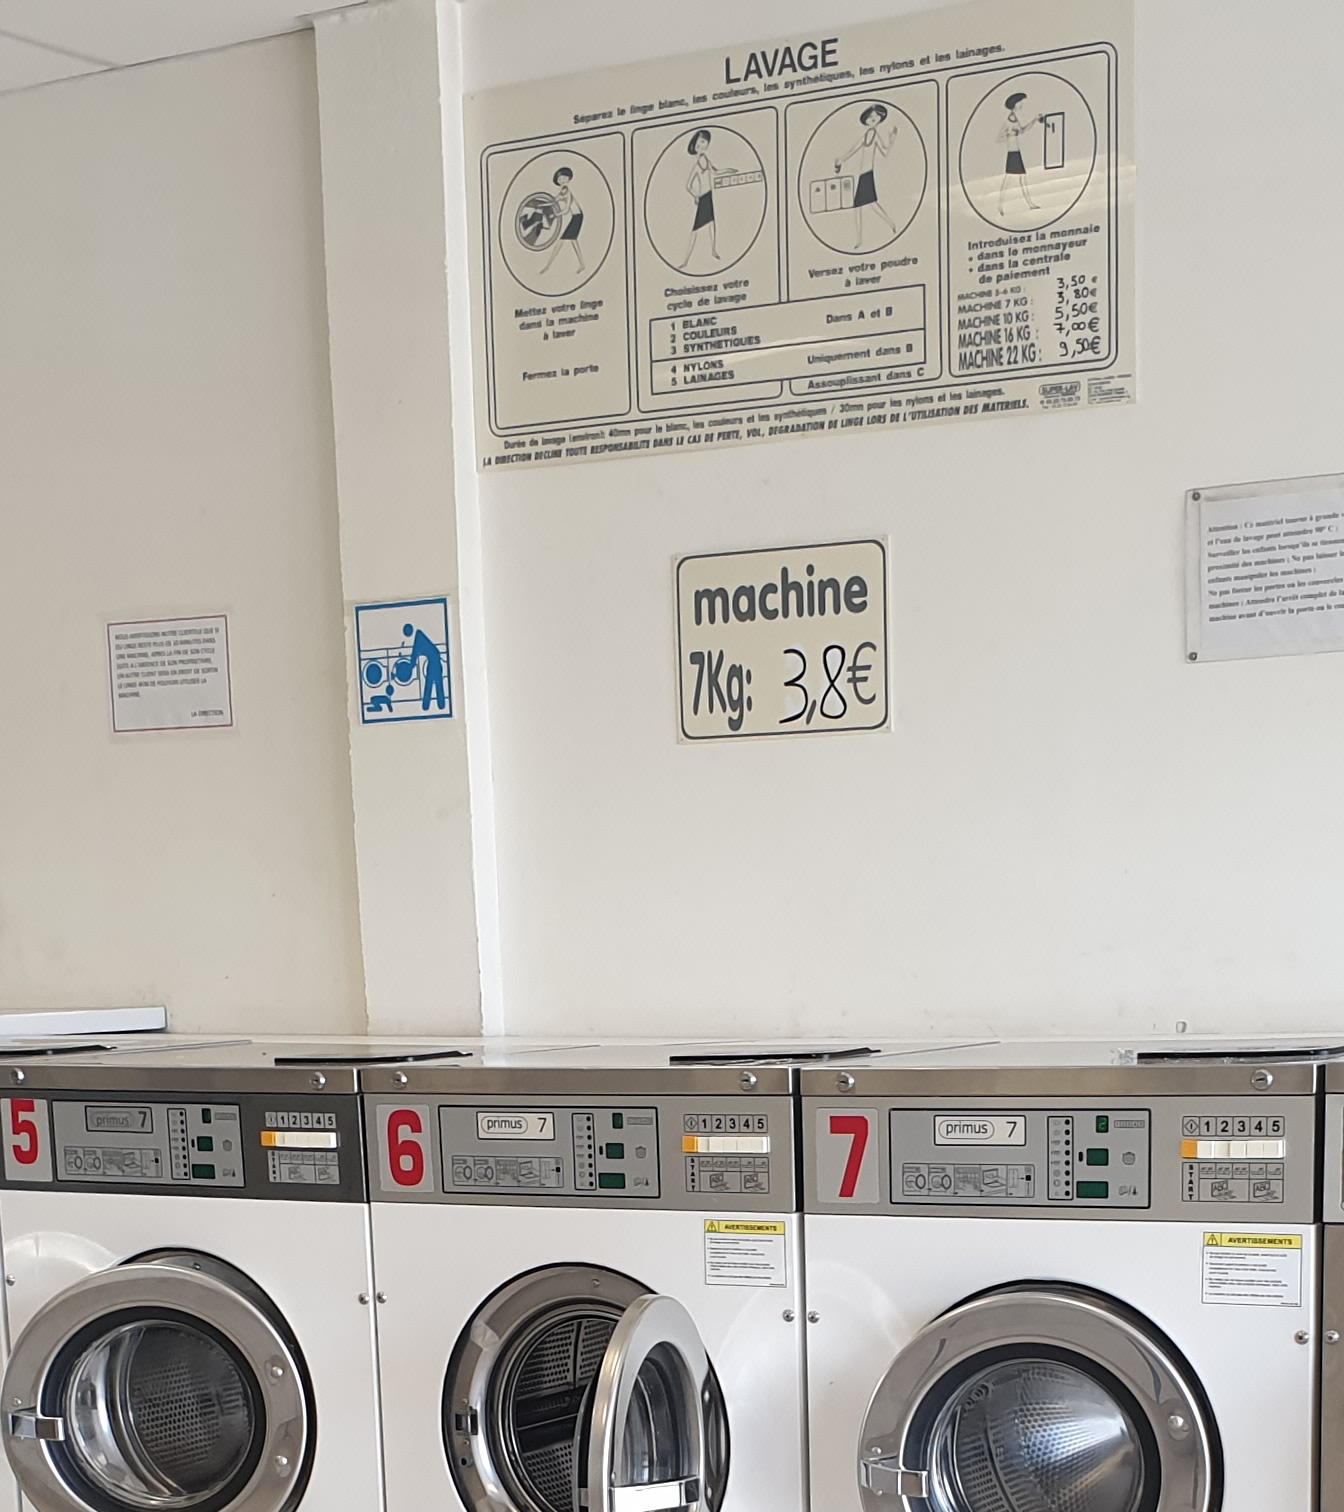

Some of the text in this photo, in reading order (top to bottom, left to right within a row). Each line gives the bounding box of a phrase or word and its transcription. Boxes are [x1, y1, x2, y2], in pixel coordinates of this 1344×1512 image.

[725, 38, 839, 84] LAVAGE
[968, 224, 1100, 251] Introduisez la monnaie
[977, 239, 1087, 261] dans le monnayeur
[978, 253, 1071, 272] dans la centrale
[979, 267, 1050, 284] de paiement
[958, 289, 992, 301] MACHINE
[1057, 275, 1085, 290] 3,50
[958, 300, 1002, 314] MACHINE
[1005, 299, 1010, 308] 7
[1014, 297, 1028, 307] KG
[671, 317, 717, 331] 1 BLANC
[826, 307, 892, 324] Dans A et B
[958, 302, 1098, 330] MACHINE 10 KG 5,50€
[671, 326, 737, 343] 2 COULEURS
[958, 317, 1099, 349] MACHINE 16 KG 7,00€
[671, 336, 761, 355] 3 SYNTHETIQUES
[807, 344, 913, 364] Uniquement dans B
[959, 336, 1100, 371] MACHINE 22 KG 9,50€
[671, 360, 723, 374] 4 NYLONS
[671, 370, 734, 386] 5 LAINAGES
[808, 368, 924, 389] Assouplissant dans C
[694, 564, 868, 626] machine
[690, 641, 877, 732] 7Kg: 3,8€
[95, 1111, 147, 1128] primus 7
[486, 1117, 547, 1134] primus 7
[702, 1119, 764, 1129] 1 2 3 4 5
[945, 1120, 1017, 1137] primus 7
[1204, 1121, 1280, 1133] 1 2 3 4 5
[10, 1099, 39, 1165] 5
[387, 1109, 424, 1186] 6
[830, 1115, 869, 1198] 7
[1228, 1237, 1293, 1245] AVERTISSEMENTS
